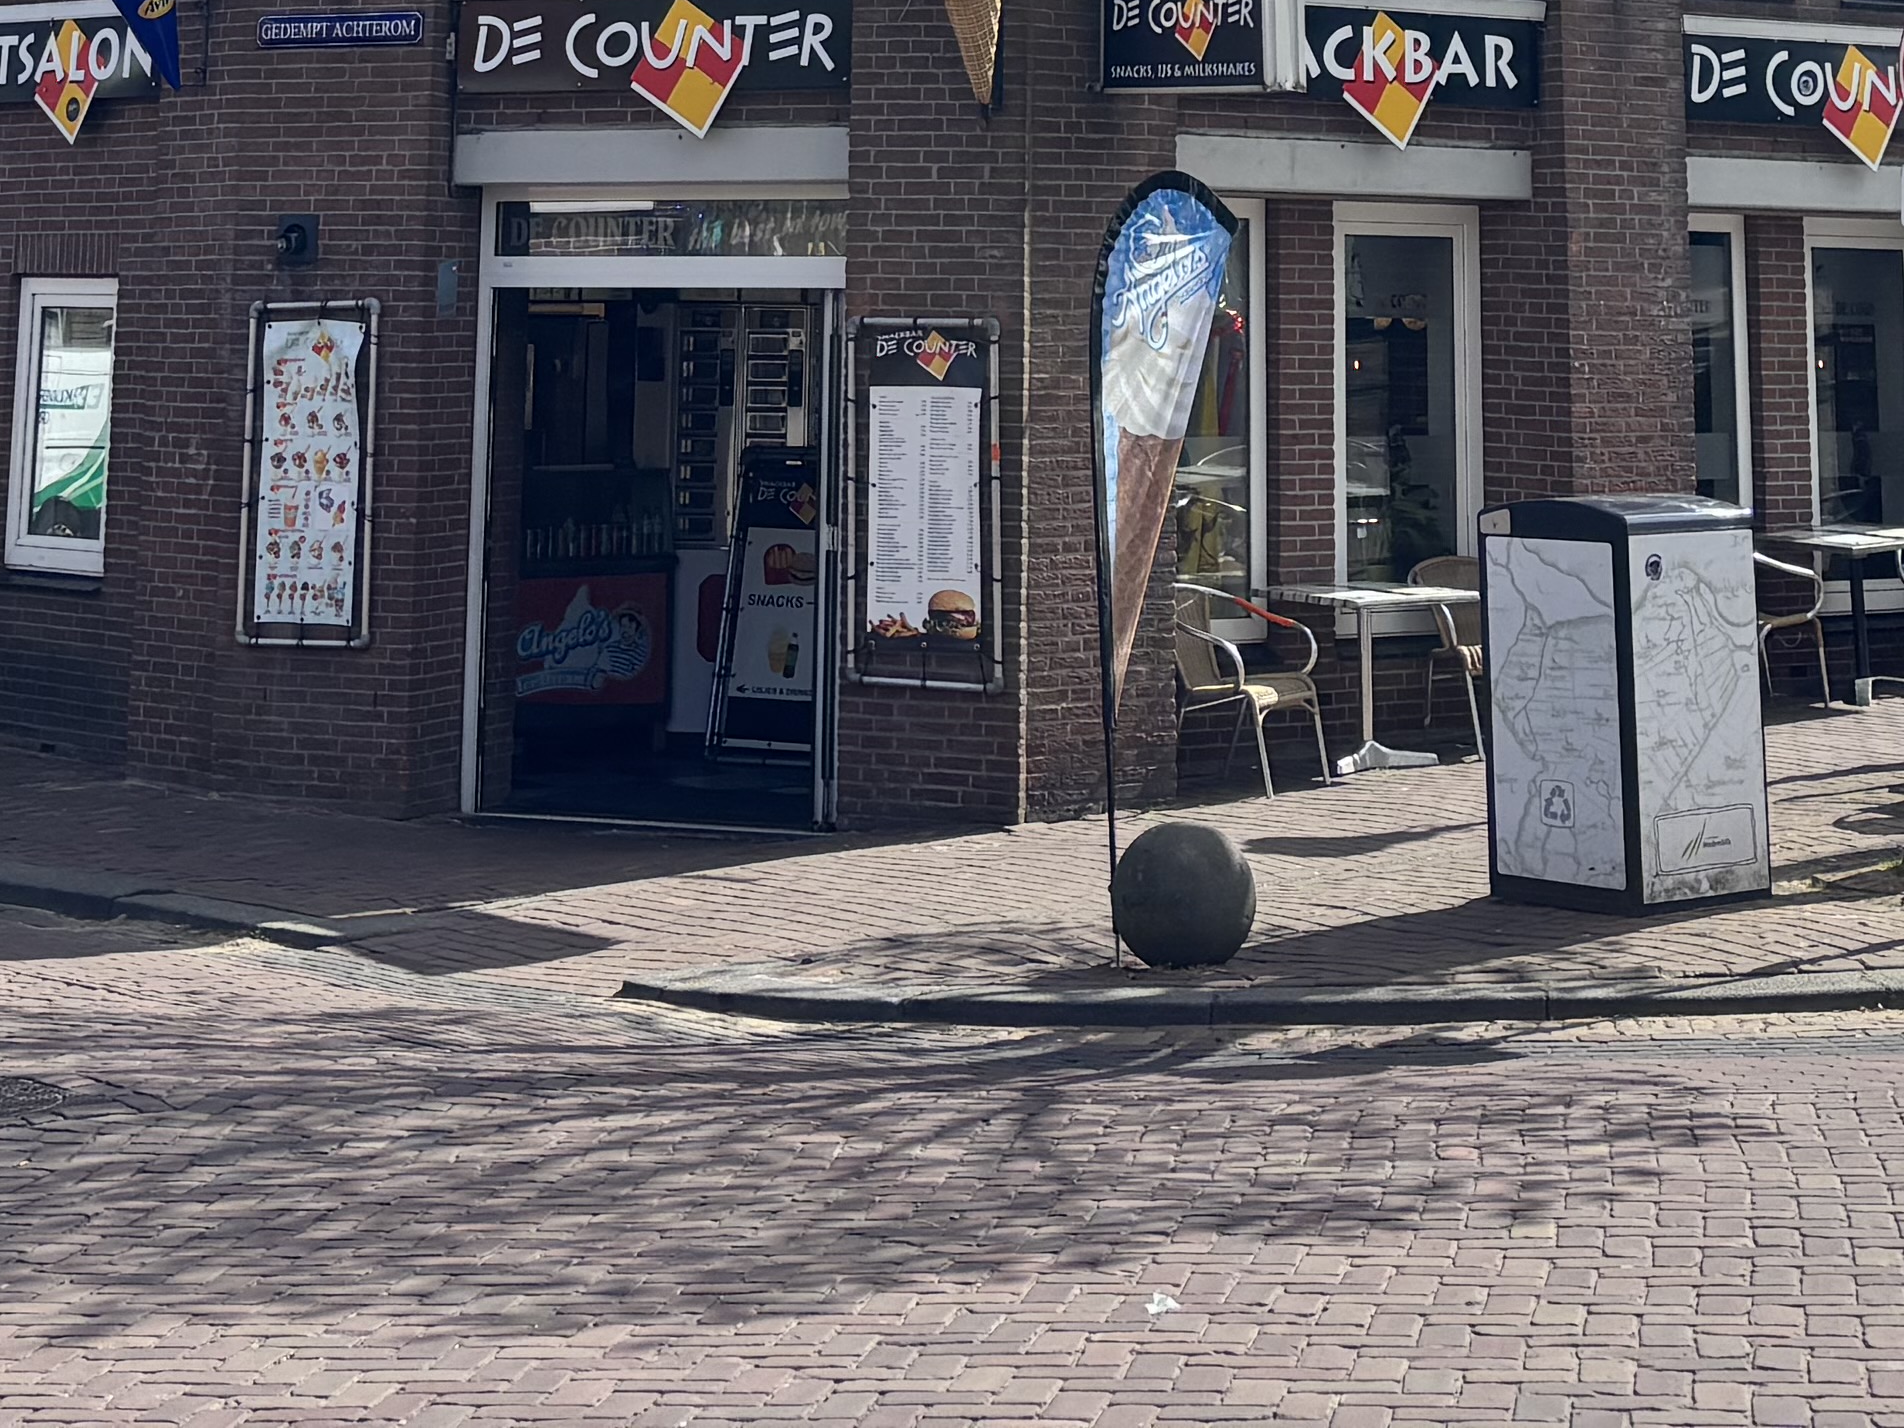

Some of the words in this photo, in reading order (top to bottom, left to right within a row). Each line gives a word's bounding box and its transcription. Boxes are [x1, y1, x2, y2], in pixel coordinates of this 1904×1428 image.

[261, 23, 331, 40] GEDEMPT
[332, 20, 416, 38] ACHTEROM
[1113, 0, 1140, 31] DE
[474, 15, 542, 74] DE
[565, 10, 835, 78] COUNTER
[1305, 24, 1518, 89] CKBAR
[1111, 64, 1155, 79] SNACKS,
[1158, 63, 1172, 78] IJS
[1174, 63, 1182, 77] &
[1184, 61, 1256, 77] MILKSHAKES
[1691, 43, 1746, 103] DE
[1766, 50, 1900, 117] COUN
[551, 215, 676, 247] COUNTER
[876, 340, 897, 357] DE
[903, 339, 977, 358] COUNTER
[758, 487, 776, 501] DE
[748, 593, 804, 609] SNACKS
[516, 609, 612, 663] Angelo's
